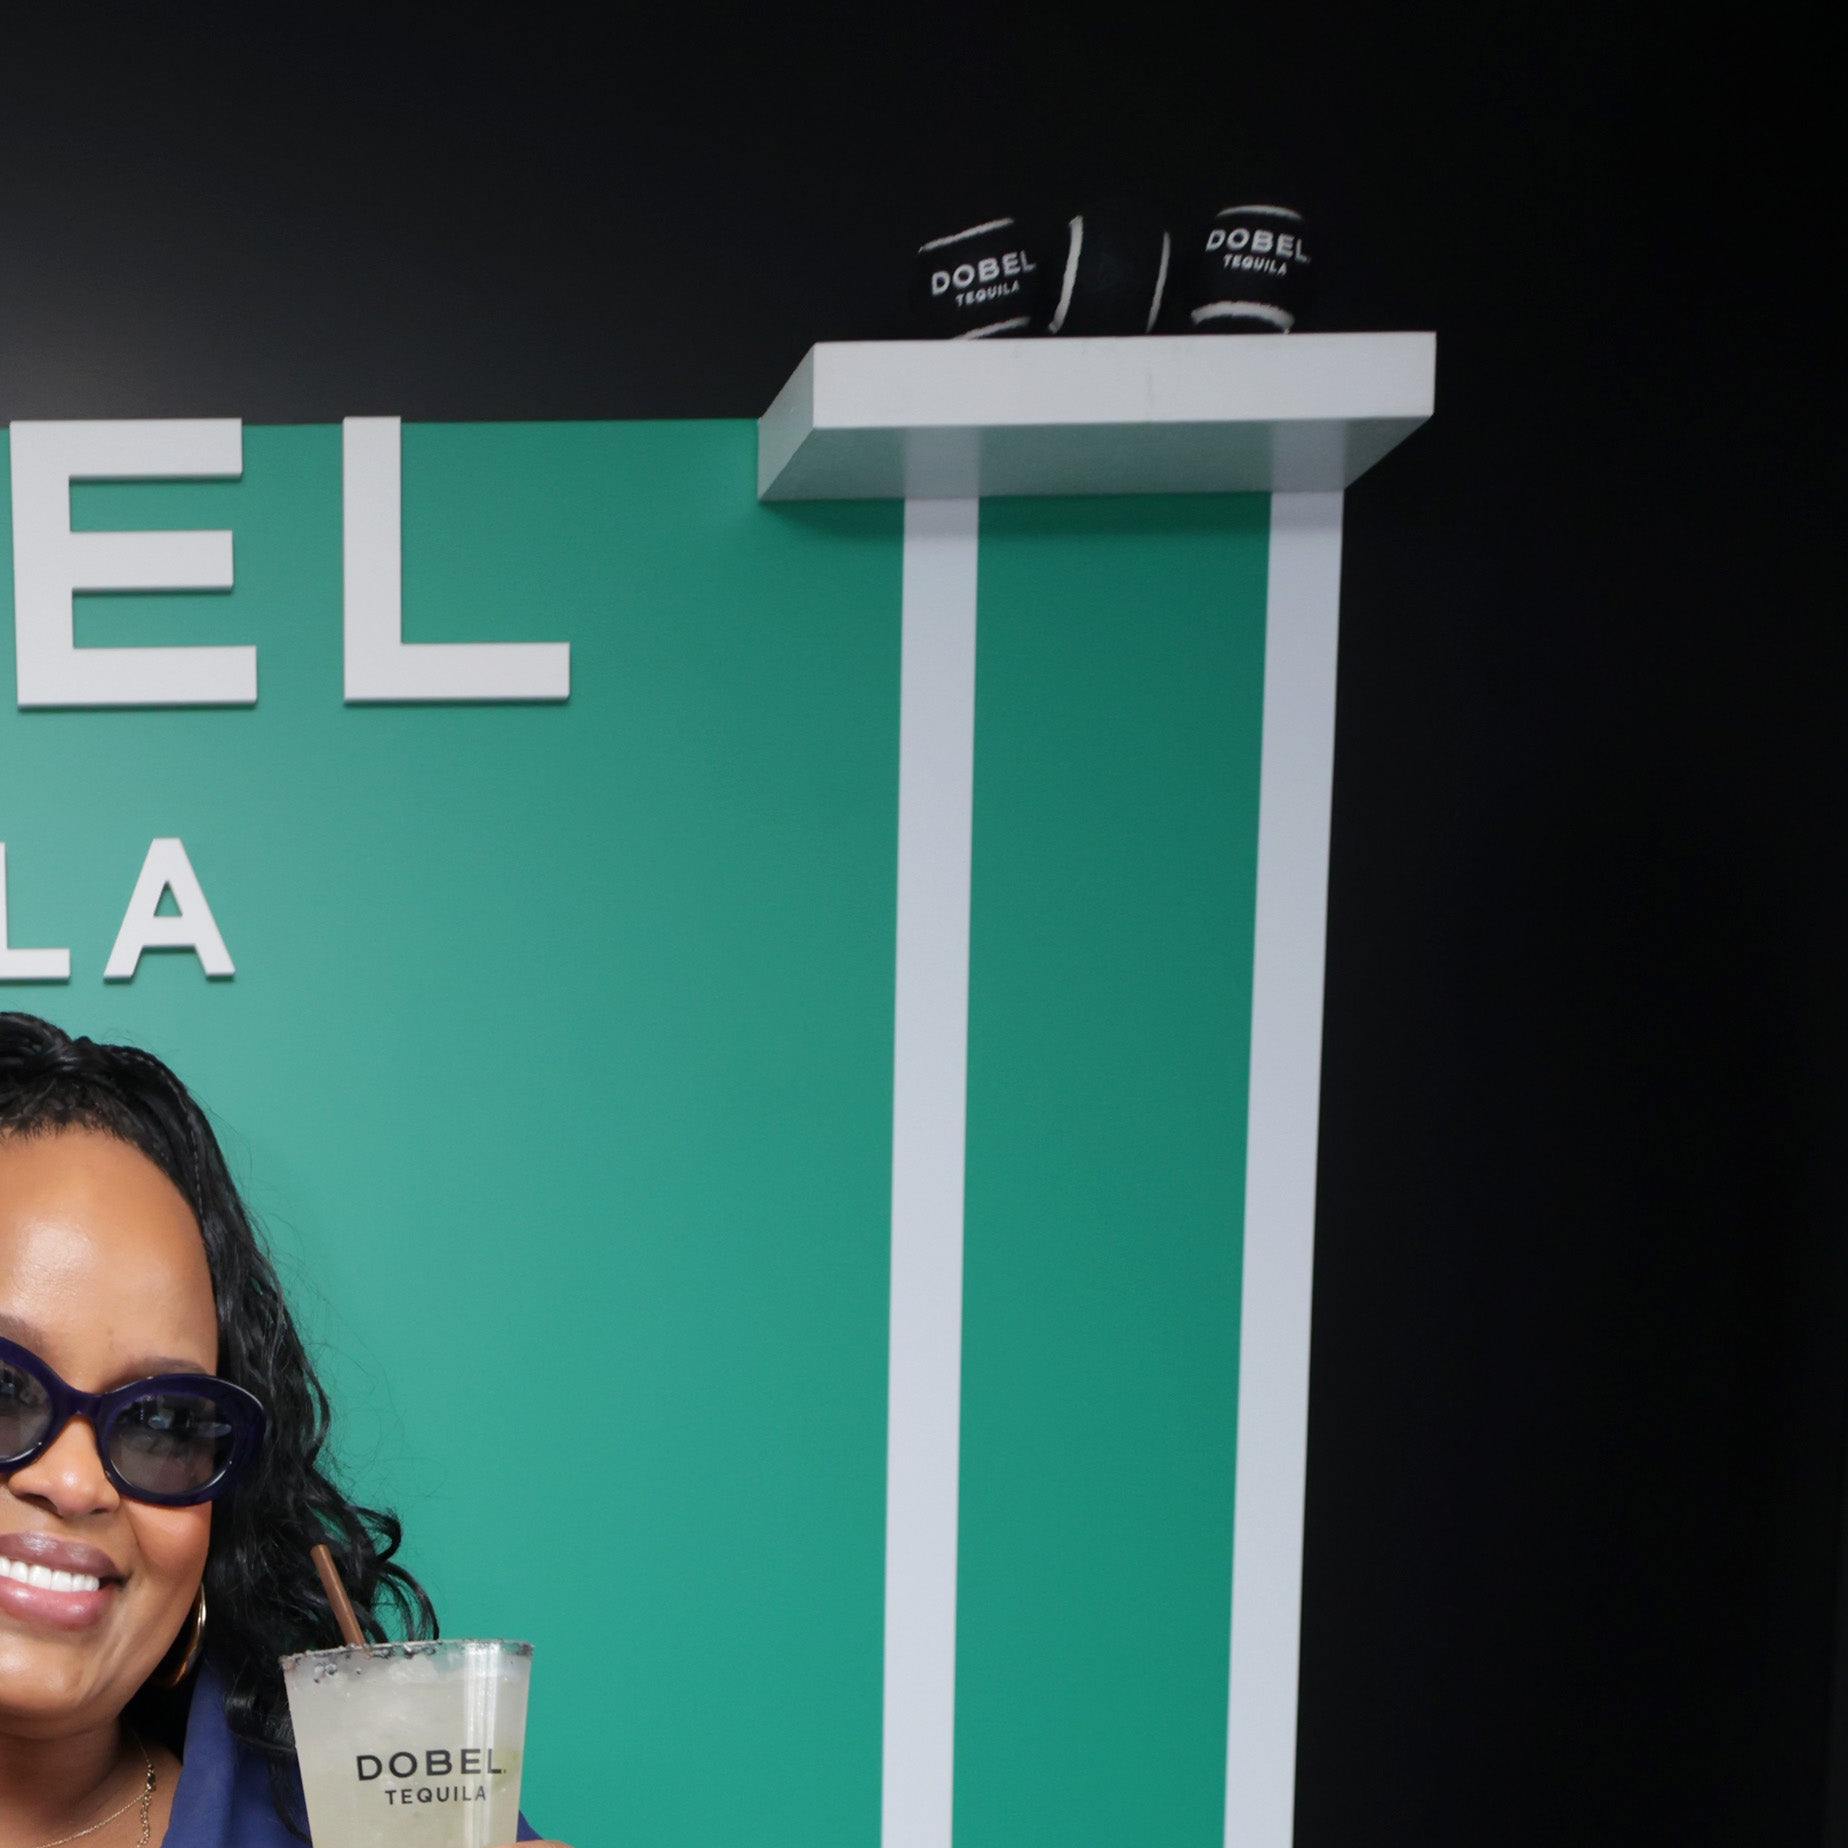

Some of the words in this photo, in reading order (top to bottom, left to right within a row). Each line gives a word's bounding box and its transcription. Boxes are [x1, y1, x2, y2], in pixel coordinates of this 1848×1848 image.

[1205, 227, 1311, 263] DOBEL
[931, 250, 1036, 296] DOBEL
[1223, 253, 1287, 277] TEQUILA
[955, 280, 1020, 307] TEQUILA
[356, 1748, 506, 1781] DOBEL
[384, 1785, 486, 1805] TEQUILA
